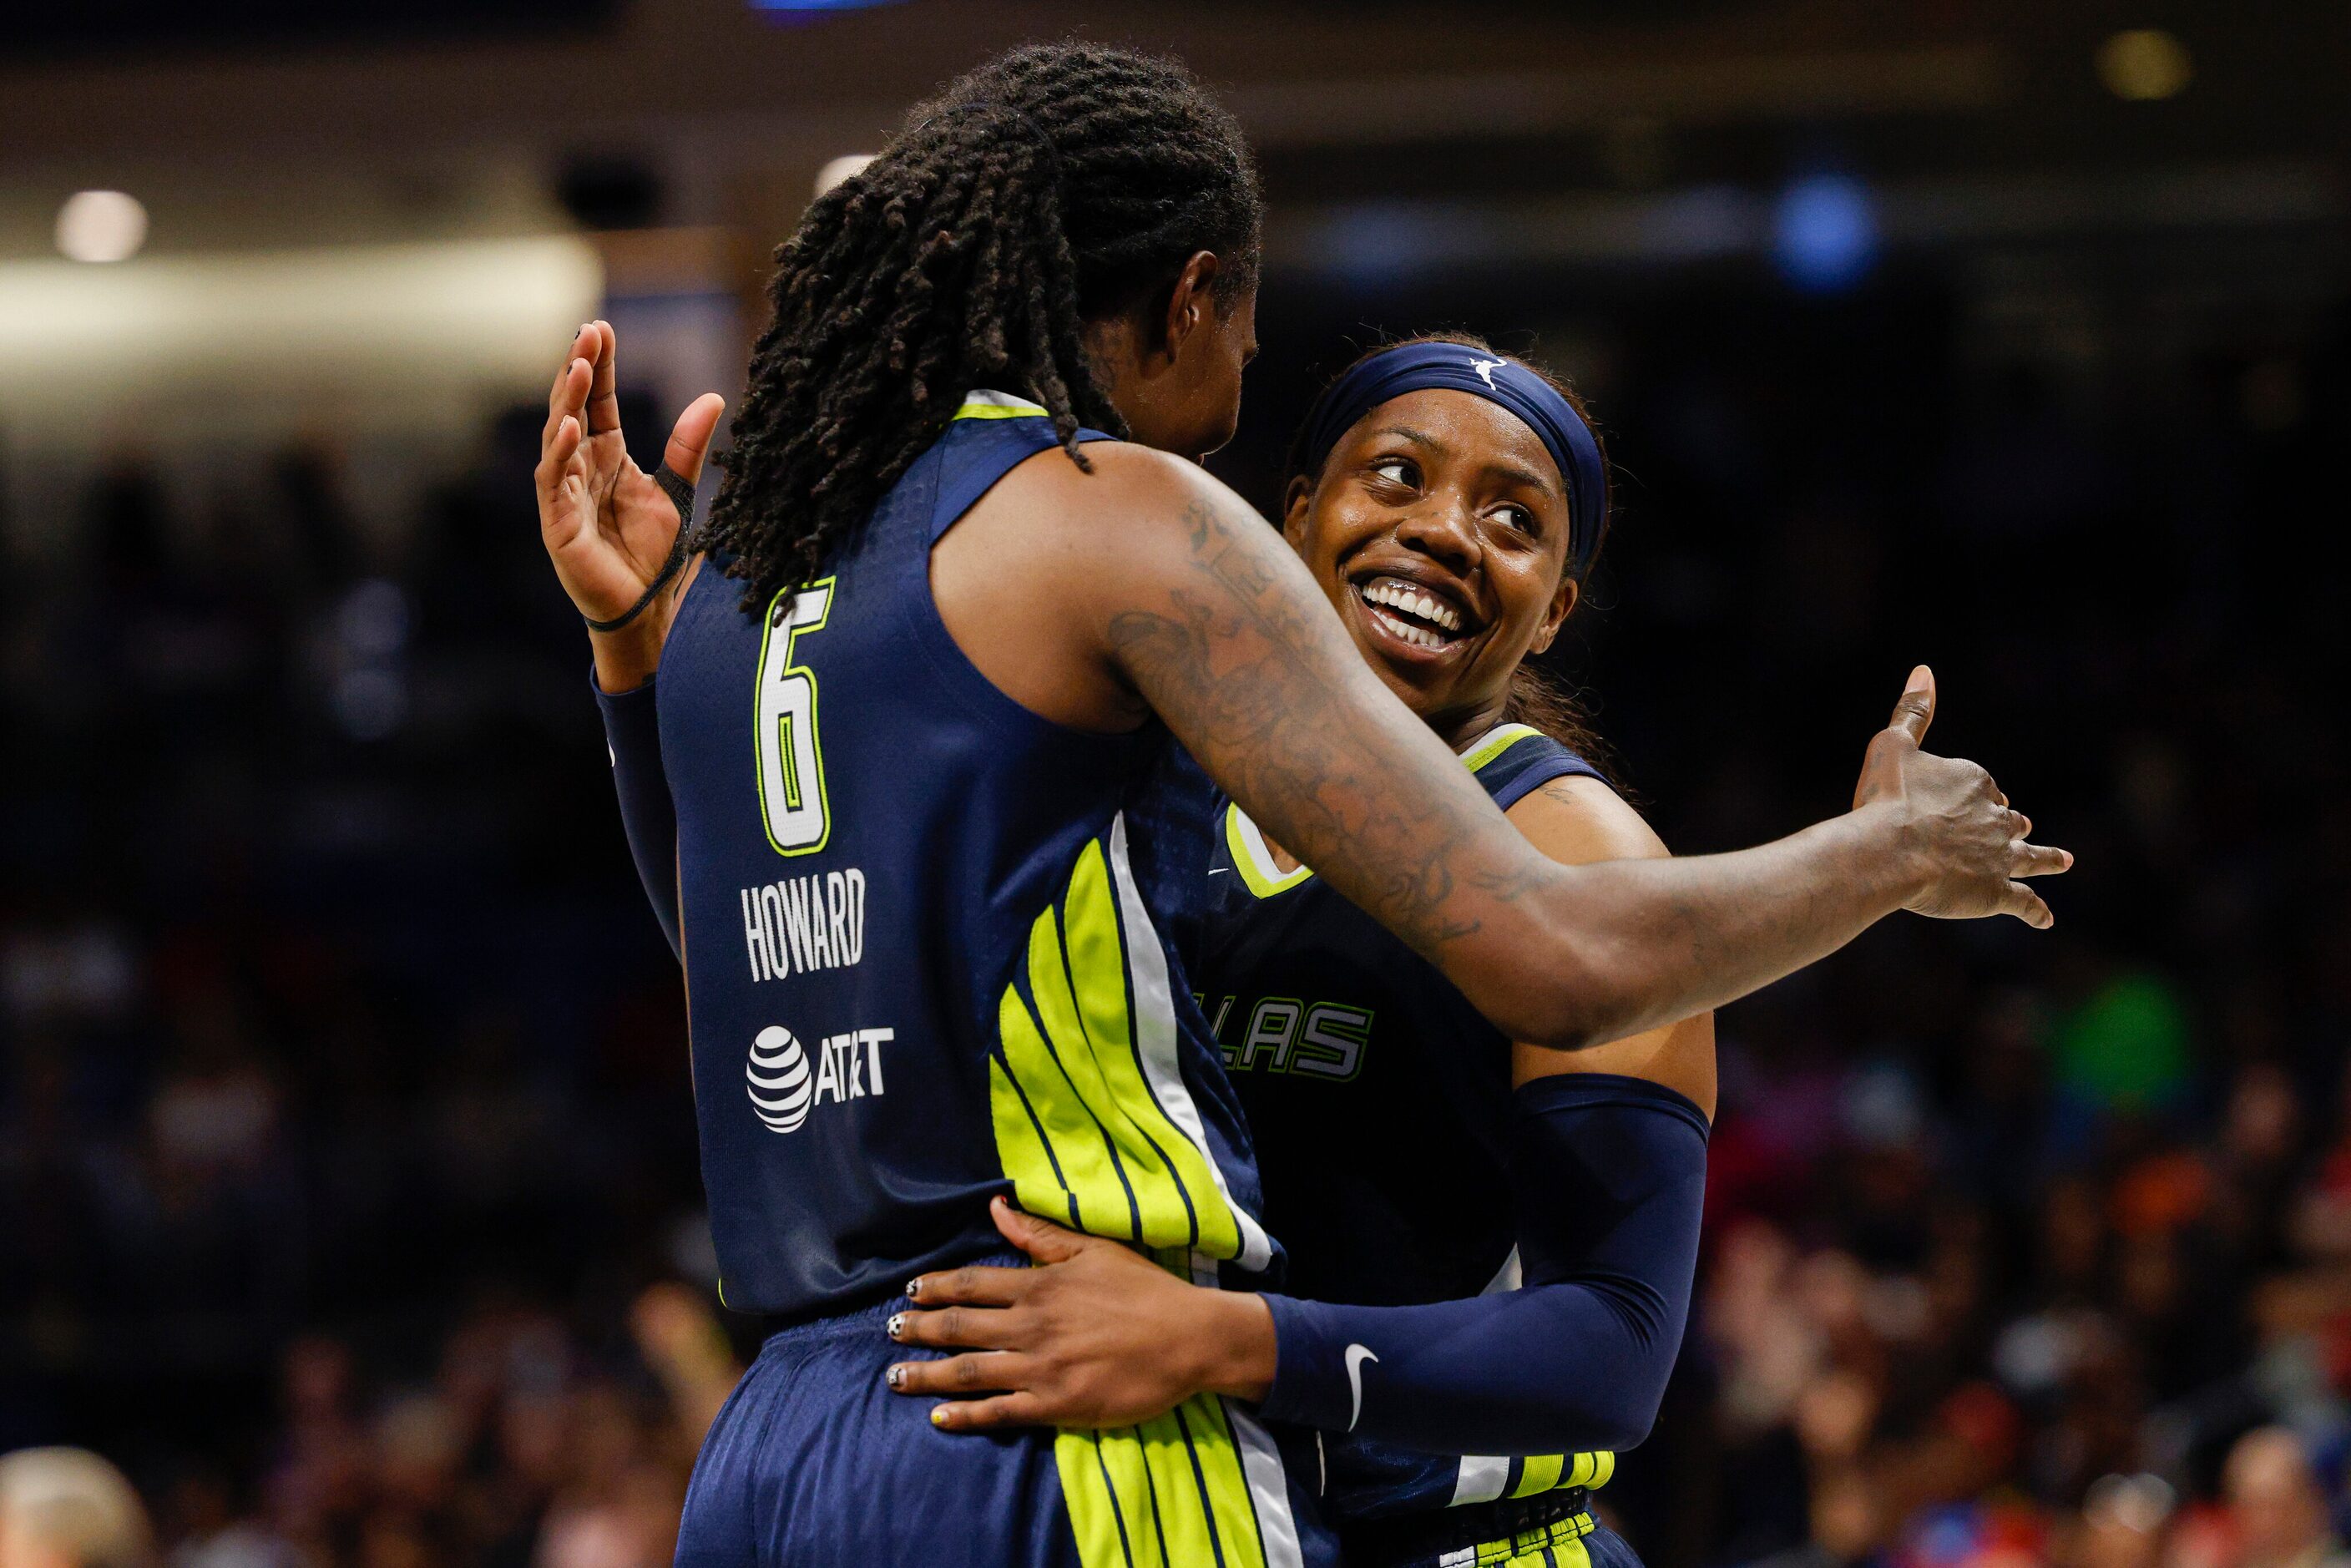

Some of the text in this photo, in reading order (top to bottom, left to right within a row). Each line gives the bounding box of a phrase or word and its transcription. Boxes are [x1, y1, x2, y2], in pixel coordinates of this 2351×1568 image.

[754, 575, 837, 857] 6
[741, 867, 866, 983] HOWARD
[814, 1027, 895, 1106] AT&T
[1193, 992, 1376, 1083] LAS
